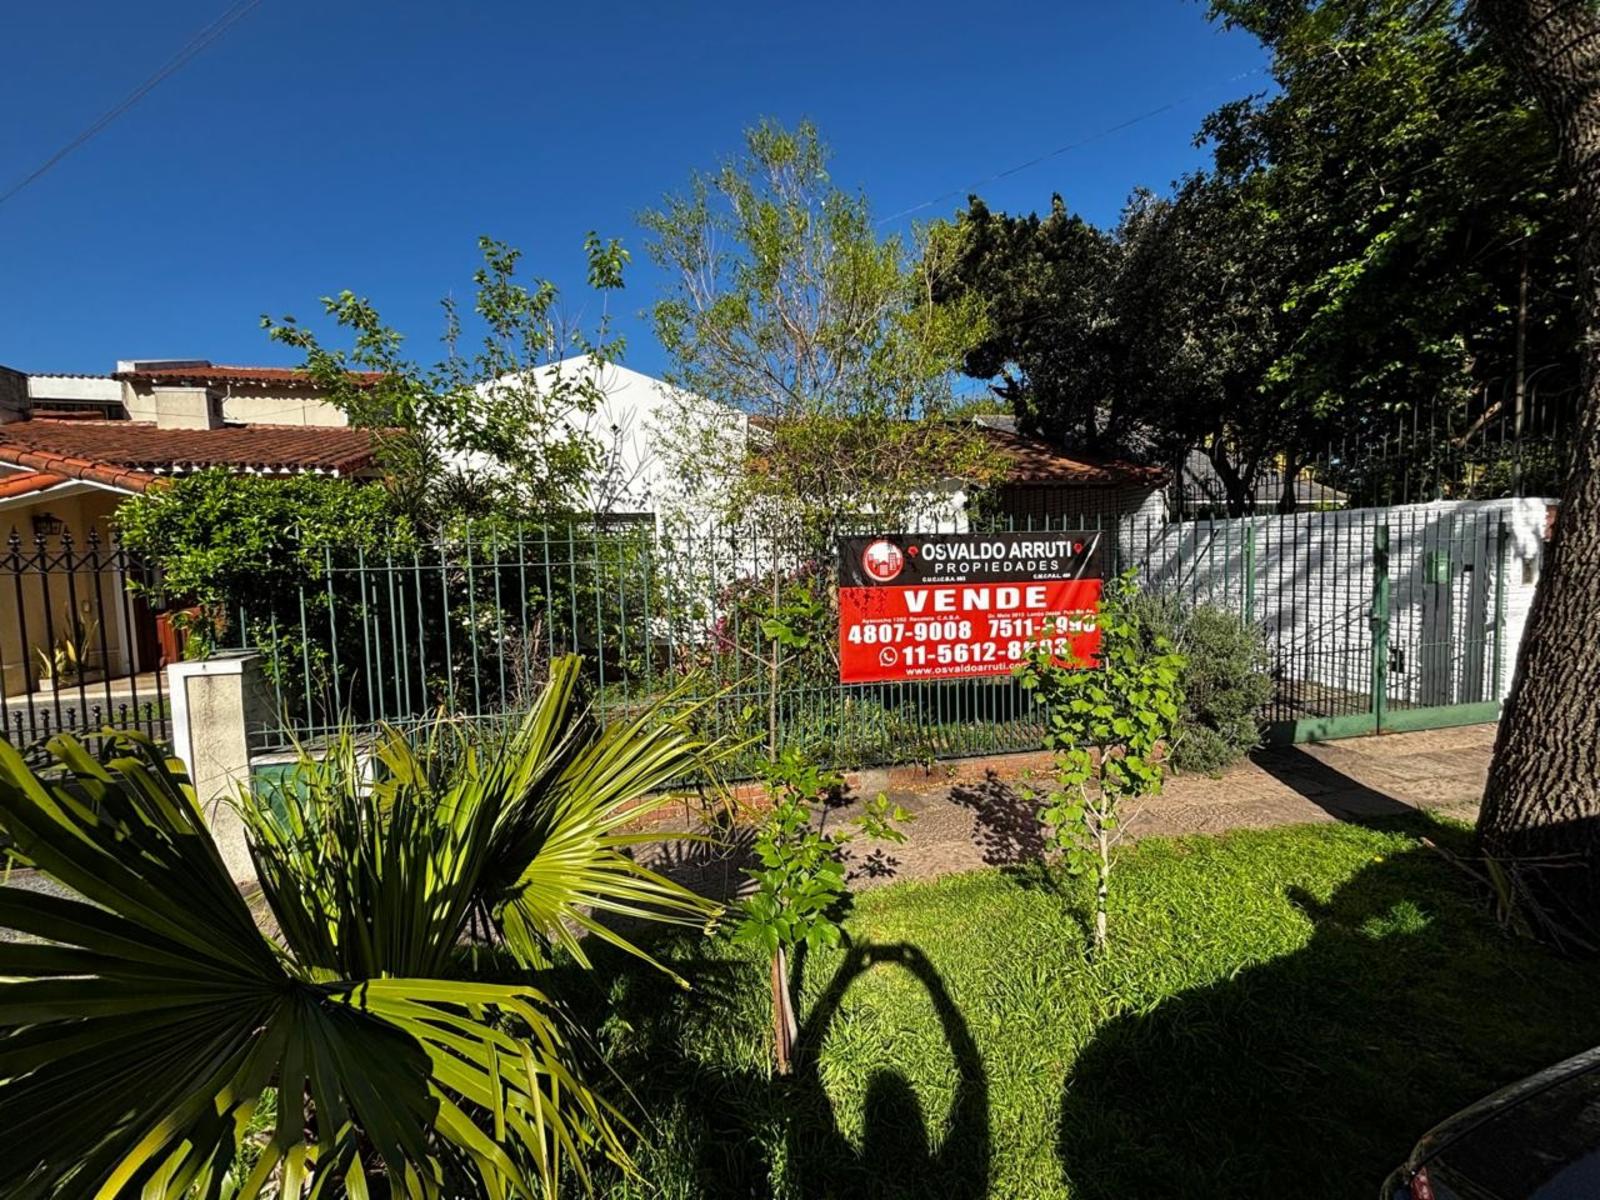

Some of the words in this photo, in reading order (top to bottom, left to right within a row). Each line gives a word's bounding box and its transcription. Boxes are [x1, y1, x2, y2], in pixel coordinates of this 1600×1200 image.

[922, 542, 1006, 561] OSVALDO
[1008, 541, 1072, 559] ARRUTI
[935, 560, 1059, 574] PROPIEDADES
[903, 586, 1048, 614] VENDE
[847, 620, 972, 645] 4807-9008
